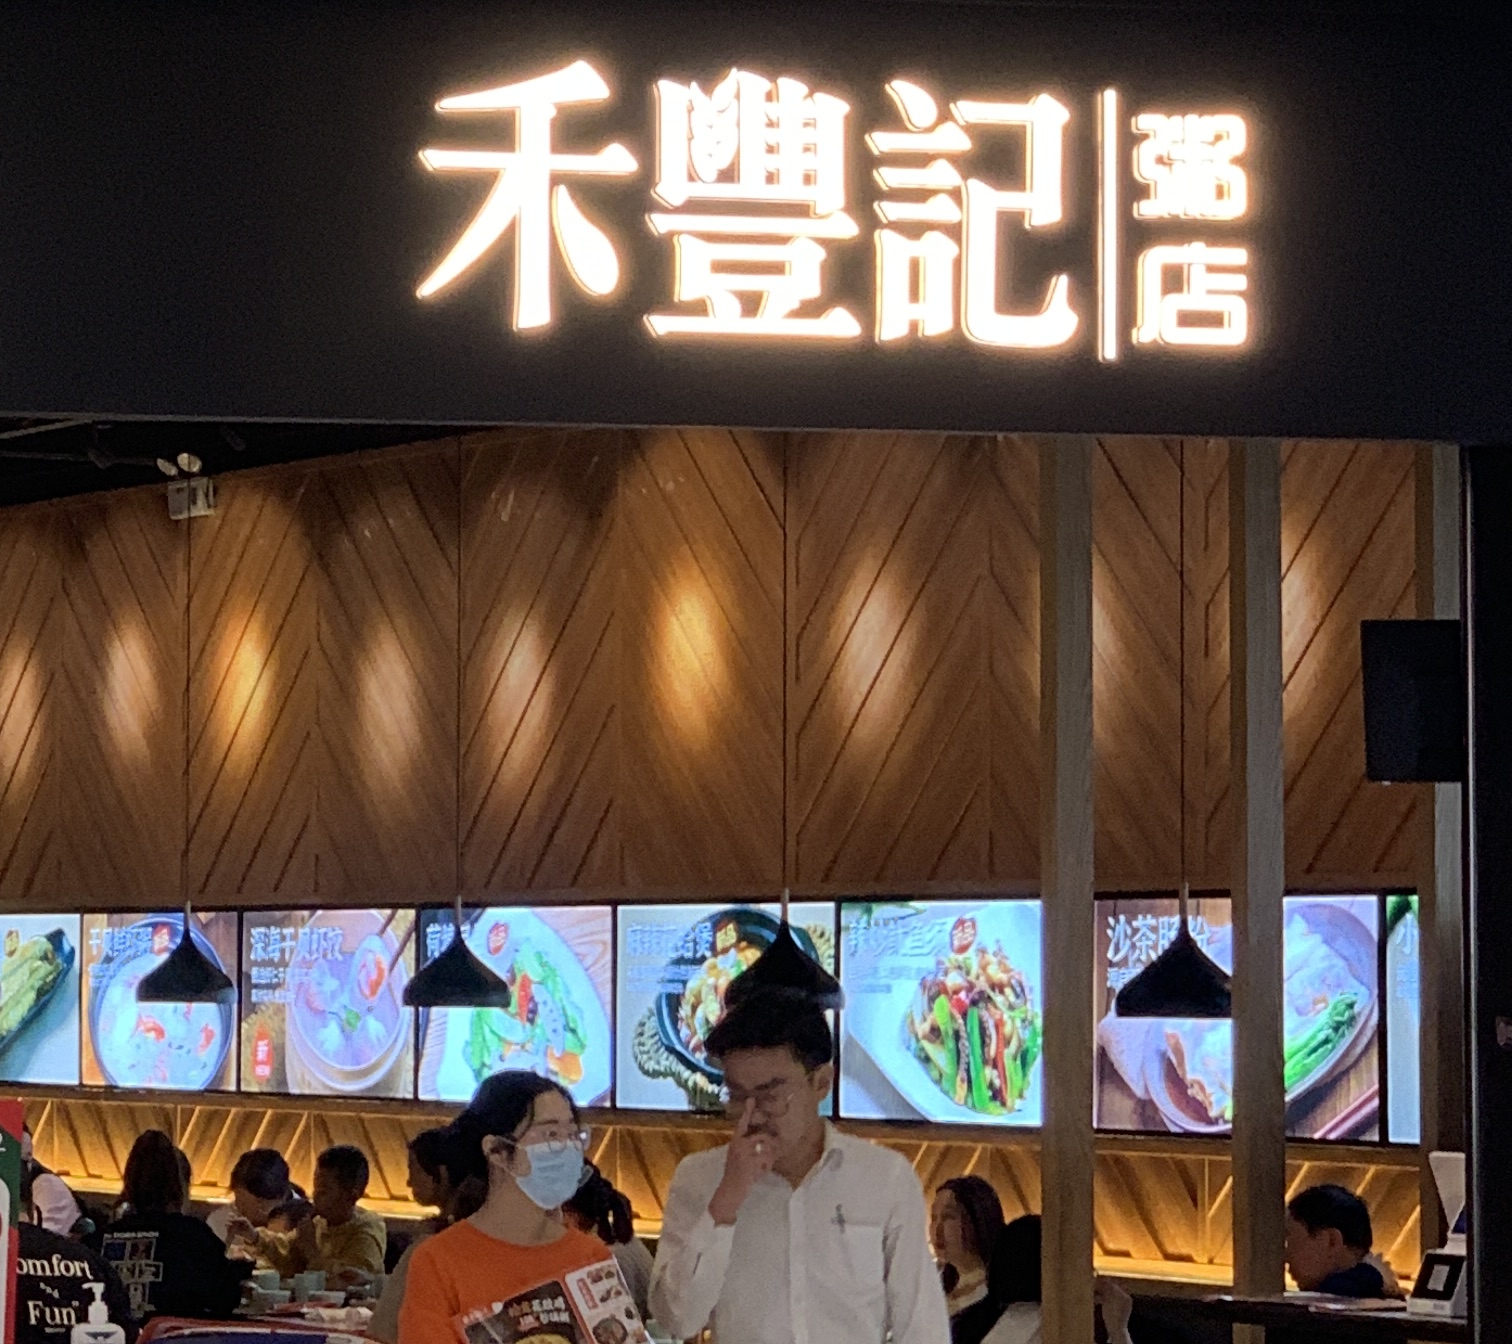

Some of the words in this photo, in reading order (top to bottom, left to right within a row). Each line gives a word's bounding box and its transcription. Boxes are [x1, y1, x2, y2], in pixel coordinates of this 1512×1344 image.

[416, 59, 1080, 349] 禾豐記
[1132, 112, 1249, 347] 粥店
[15, 1254, 93, 1280] omfort
